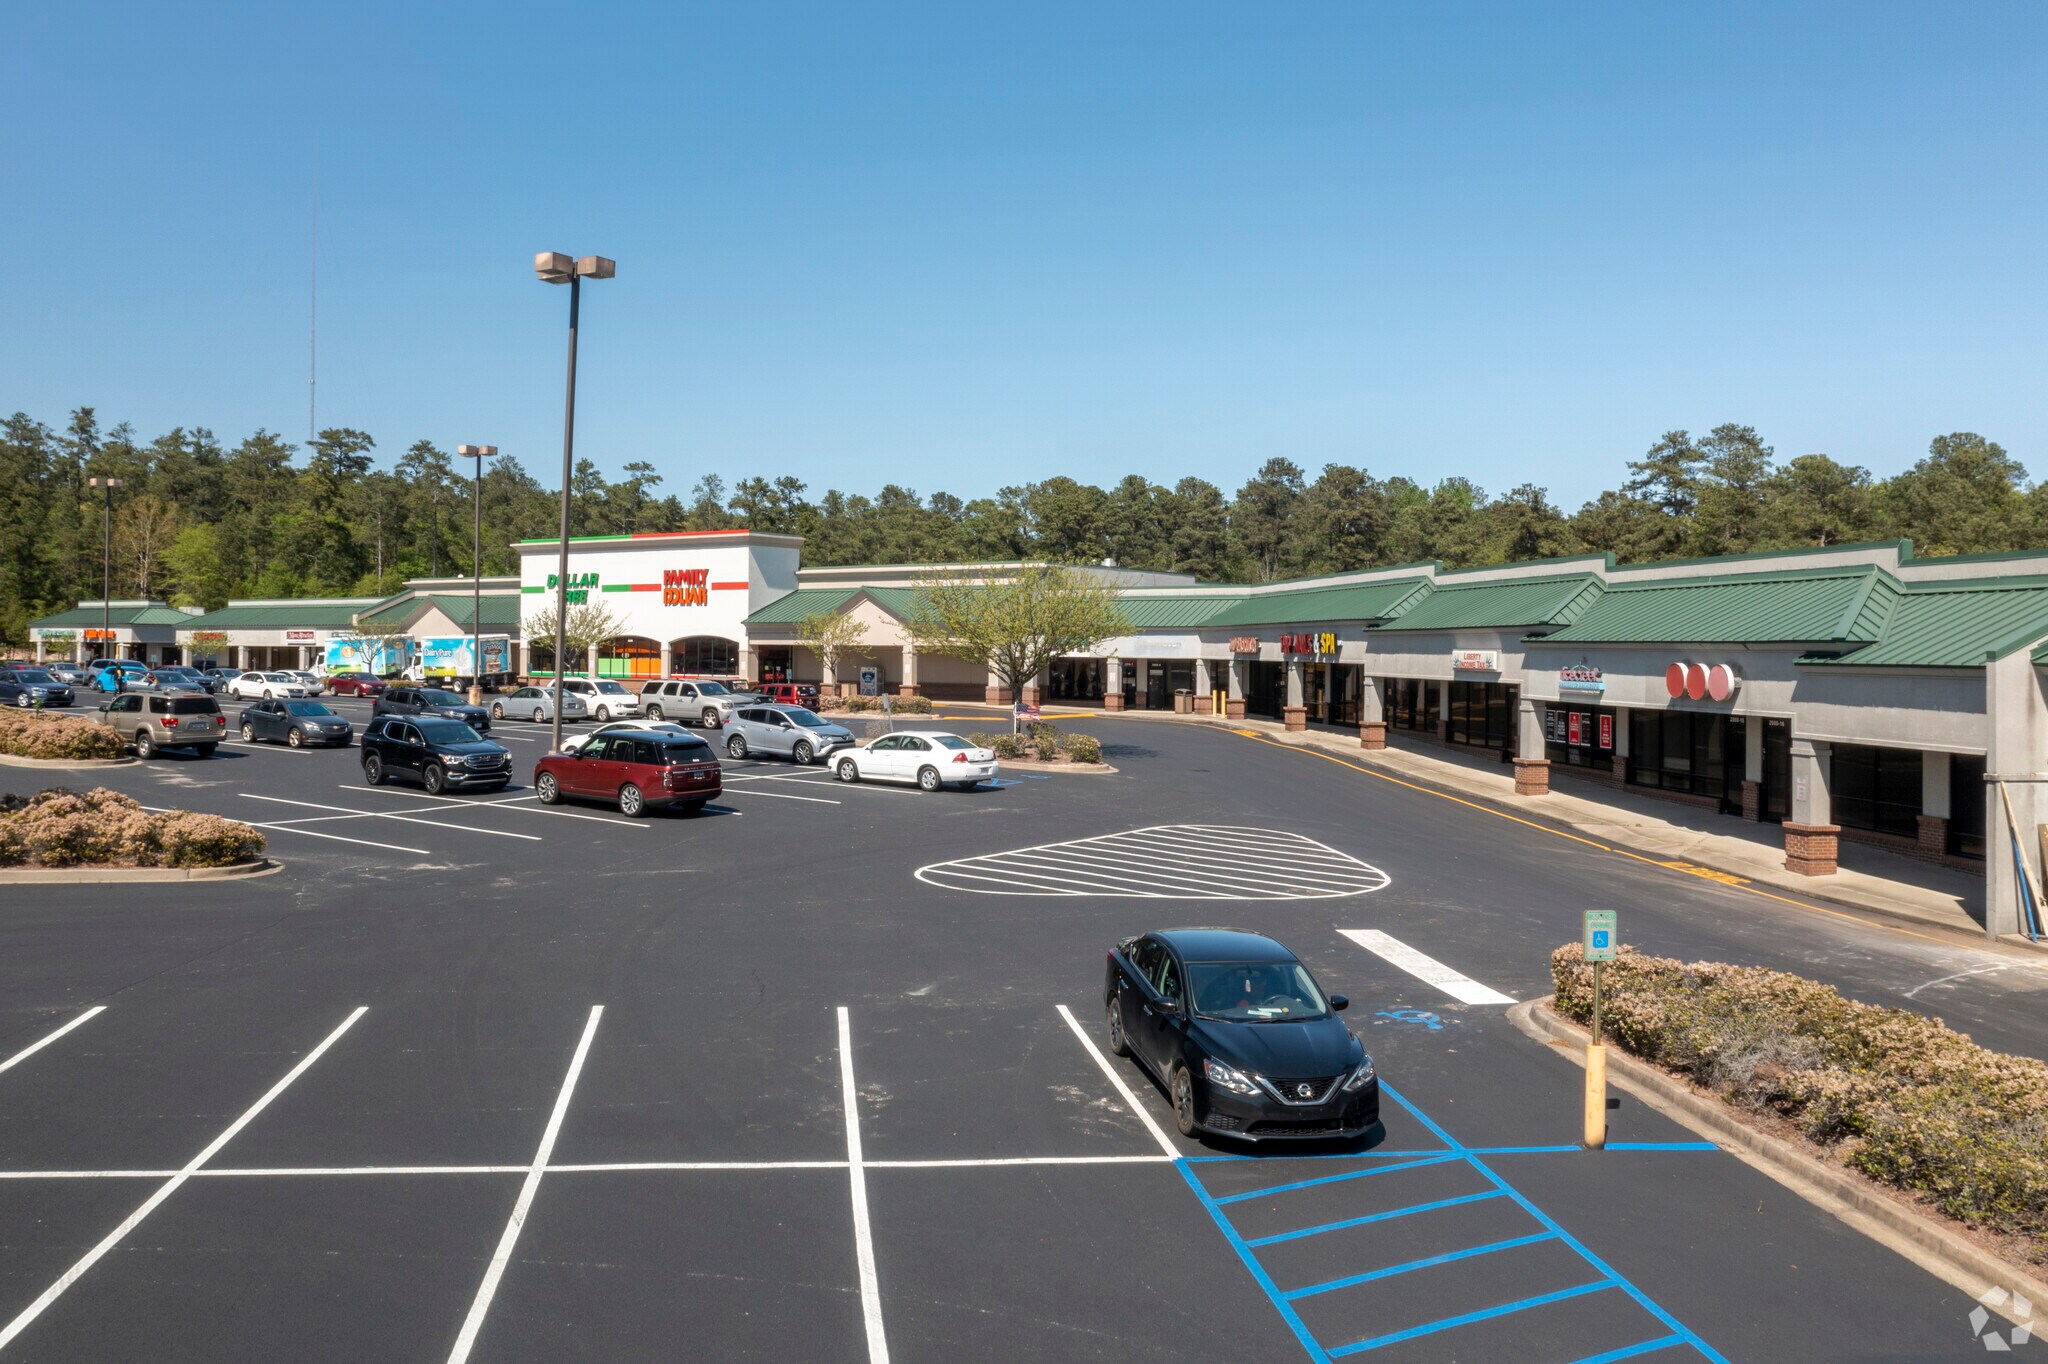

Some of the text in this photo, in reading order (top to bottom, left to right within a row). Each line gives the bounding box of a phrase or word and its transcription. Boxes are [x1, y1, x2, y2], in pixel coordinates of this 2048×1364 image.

[663, 568, 709, 587] FAMILY
[556, 589, 589, 606] REE
[663, 586, 708, 606] DOLLAR
[1313, 633, 1320, 654] &
[1321, 632, 1335, 654] SPA
